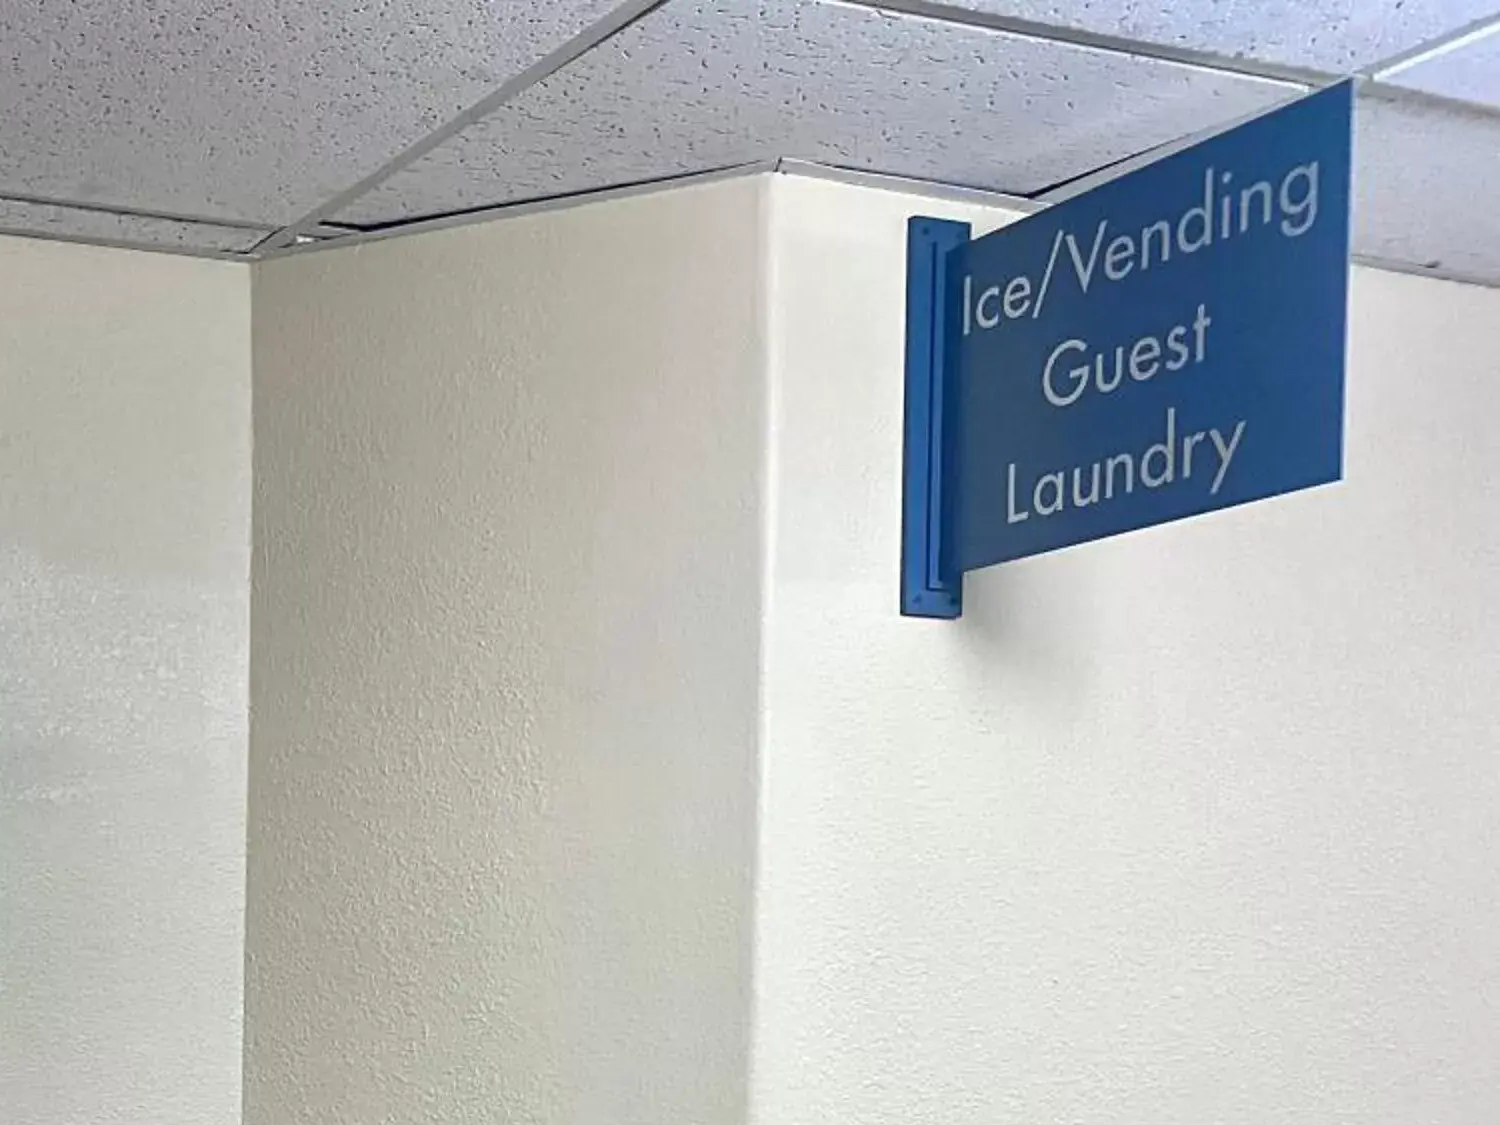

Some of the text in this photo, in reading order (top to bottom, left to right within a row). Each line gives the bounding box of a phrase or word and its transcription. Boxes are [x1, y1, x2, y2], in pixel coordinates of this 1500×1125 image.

[961, 159, 1320, 336] Ice/Vending
[1041, 303, 1212, 407] Guest
[1006, 407, 1247, 525] Laundry
